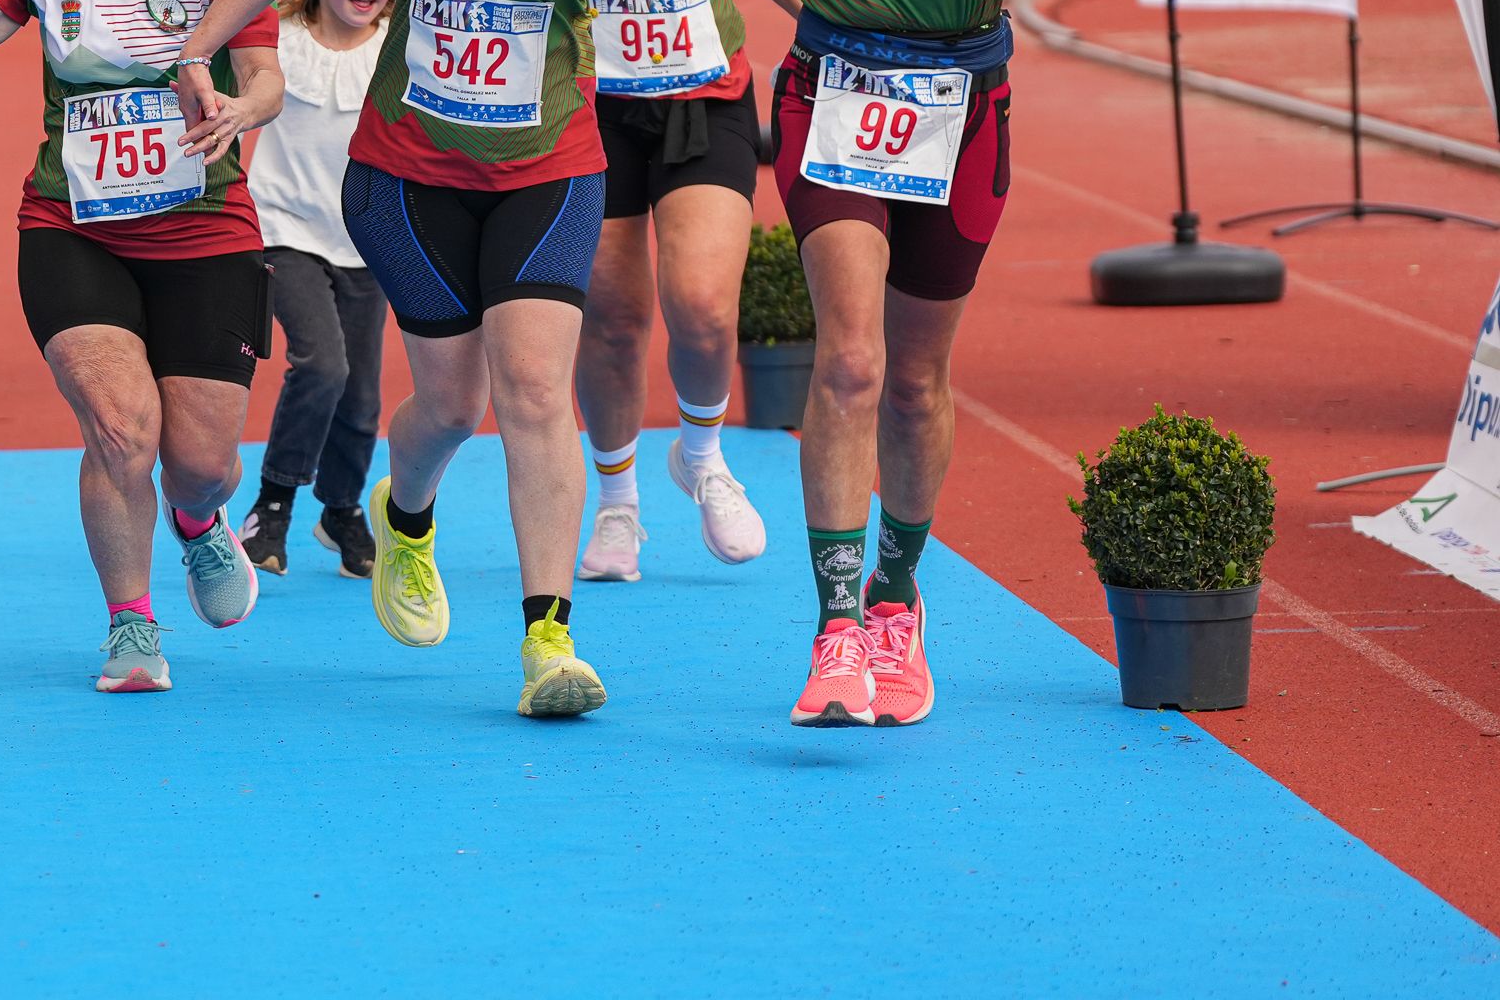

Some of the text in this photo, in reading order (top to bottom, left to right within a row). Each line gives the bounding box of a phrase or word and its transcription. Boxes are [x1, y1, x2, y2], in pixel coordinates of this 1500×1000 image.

[491, 21, 510, 31] 2026
[620, 15, 694, 63] 954
[432, 32, 510, 86] 542
[81, 95, 118, 129] 21K
[143, 110, 161, 120] 2026
[855, 101, 918, 156] 99
[90, 127, 167, 181] 755
